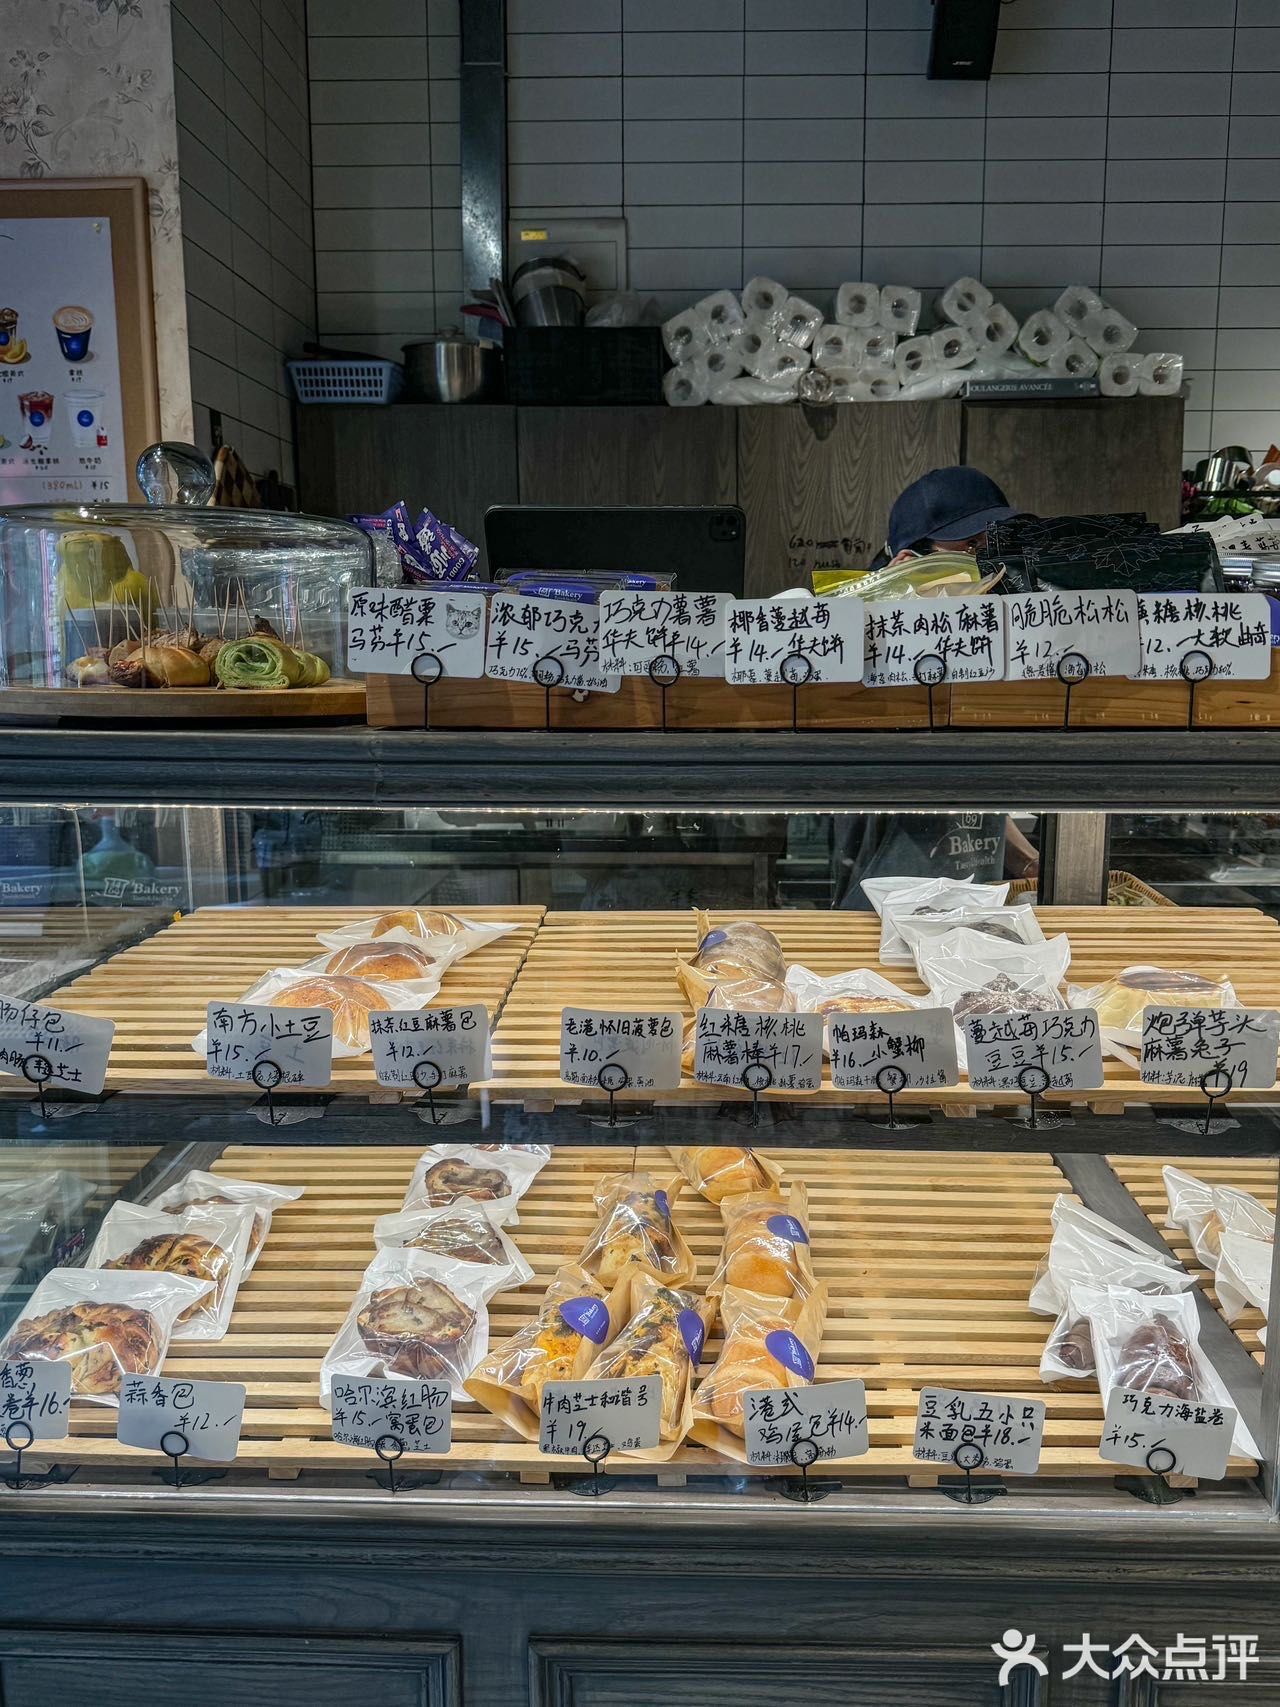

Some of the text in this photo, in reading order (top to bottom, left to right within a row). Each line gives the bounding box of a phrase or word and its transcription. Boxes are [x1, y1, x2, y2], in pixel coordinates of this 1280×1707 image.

[553, 587, 583, 600] Bakery
[350, 591, 436, 626] 原味醋栗
[1011, 595, 1129, 630] 脆脆松松
[948, 833, 1001, 855] Bakery
[3, 882, 42, 895] Bakery
[130, 881, 183, 897] Bakery
[212, 1007, 331, 1043] 南方小土豆
[698, 1012, 806, 1039] 红糖核桃
[832, 1020, 890, 1043] 帕玛森
[968, 1013, 1095, 1044] 蔓越莓巧克力
[1143, 1009, 1267, 1038] 炮弹芋头
[125, 1380, 195, 1409] 蒜香包
[334, 1383, 448, 1410] 哈尔滨红肠
[542, 1384, 648, 1415] 牛肉芝士和谐号
[749, 1391, 804, 1422] 港式
[1121, 1394, 1224, 1425] 巧克力海盐卷
